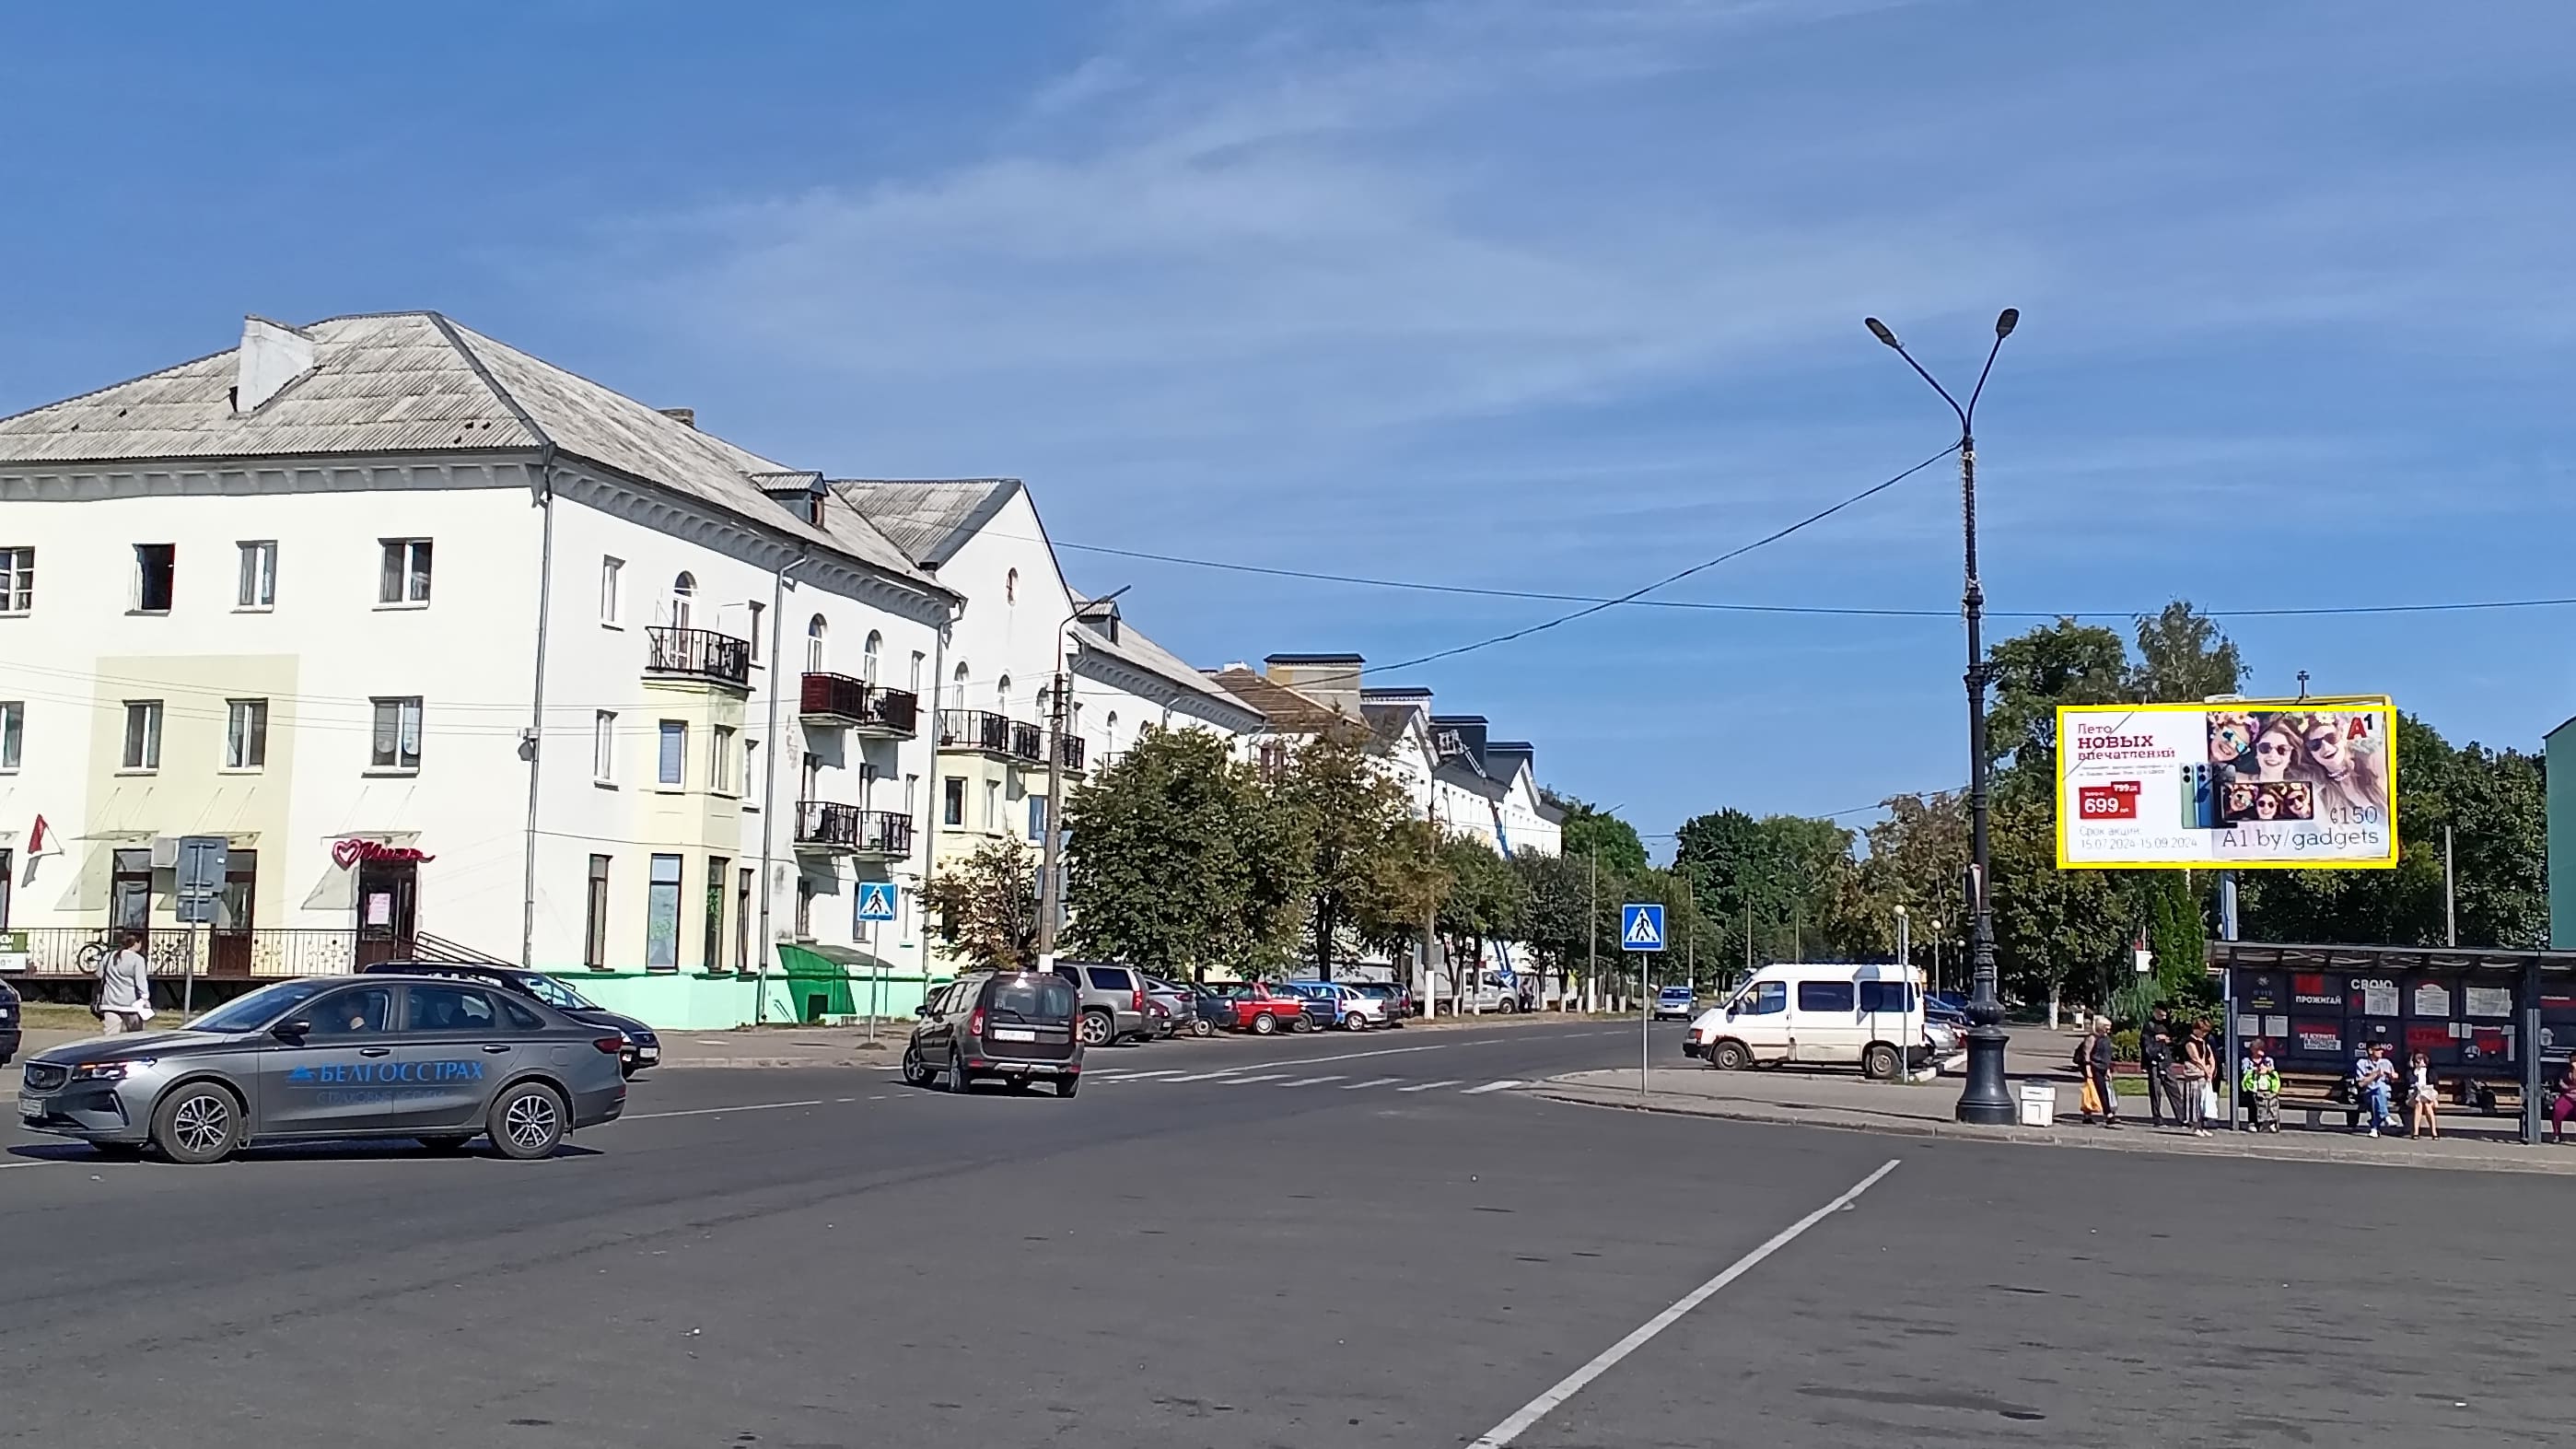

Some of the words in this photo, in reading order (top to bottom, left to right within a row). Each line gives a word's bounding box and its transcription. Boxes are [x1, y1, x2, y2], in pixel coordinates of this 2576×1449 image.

[2078, 723, 2113, 734] Лето
[2348, 714, 2373, 740] A1
[2078, 748, 2175, 761] впечатлений
[2084, 798, 2119, 813] 699
[2080, 826, 2104, 836] Срок
[2222, 827, 2379, 850] A1.by/gadgets
[2295, 996, 2342, 1004] ПРОЖИГАЙ
[321, 1061, 484, 1082] БЕЛГОССТРАХ
